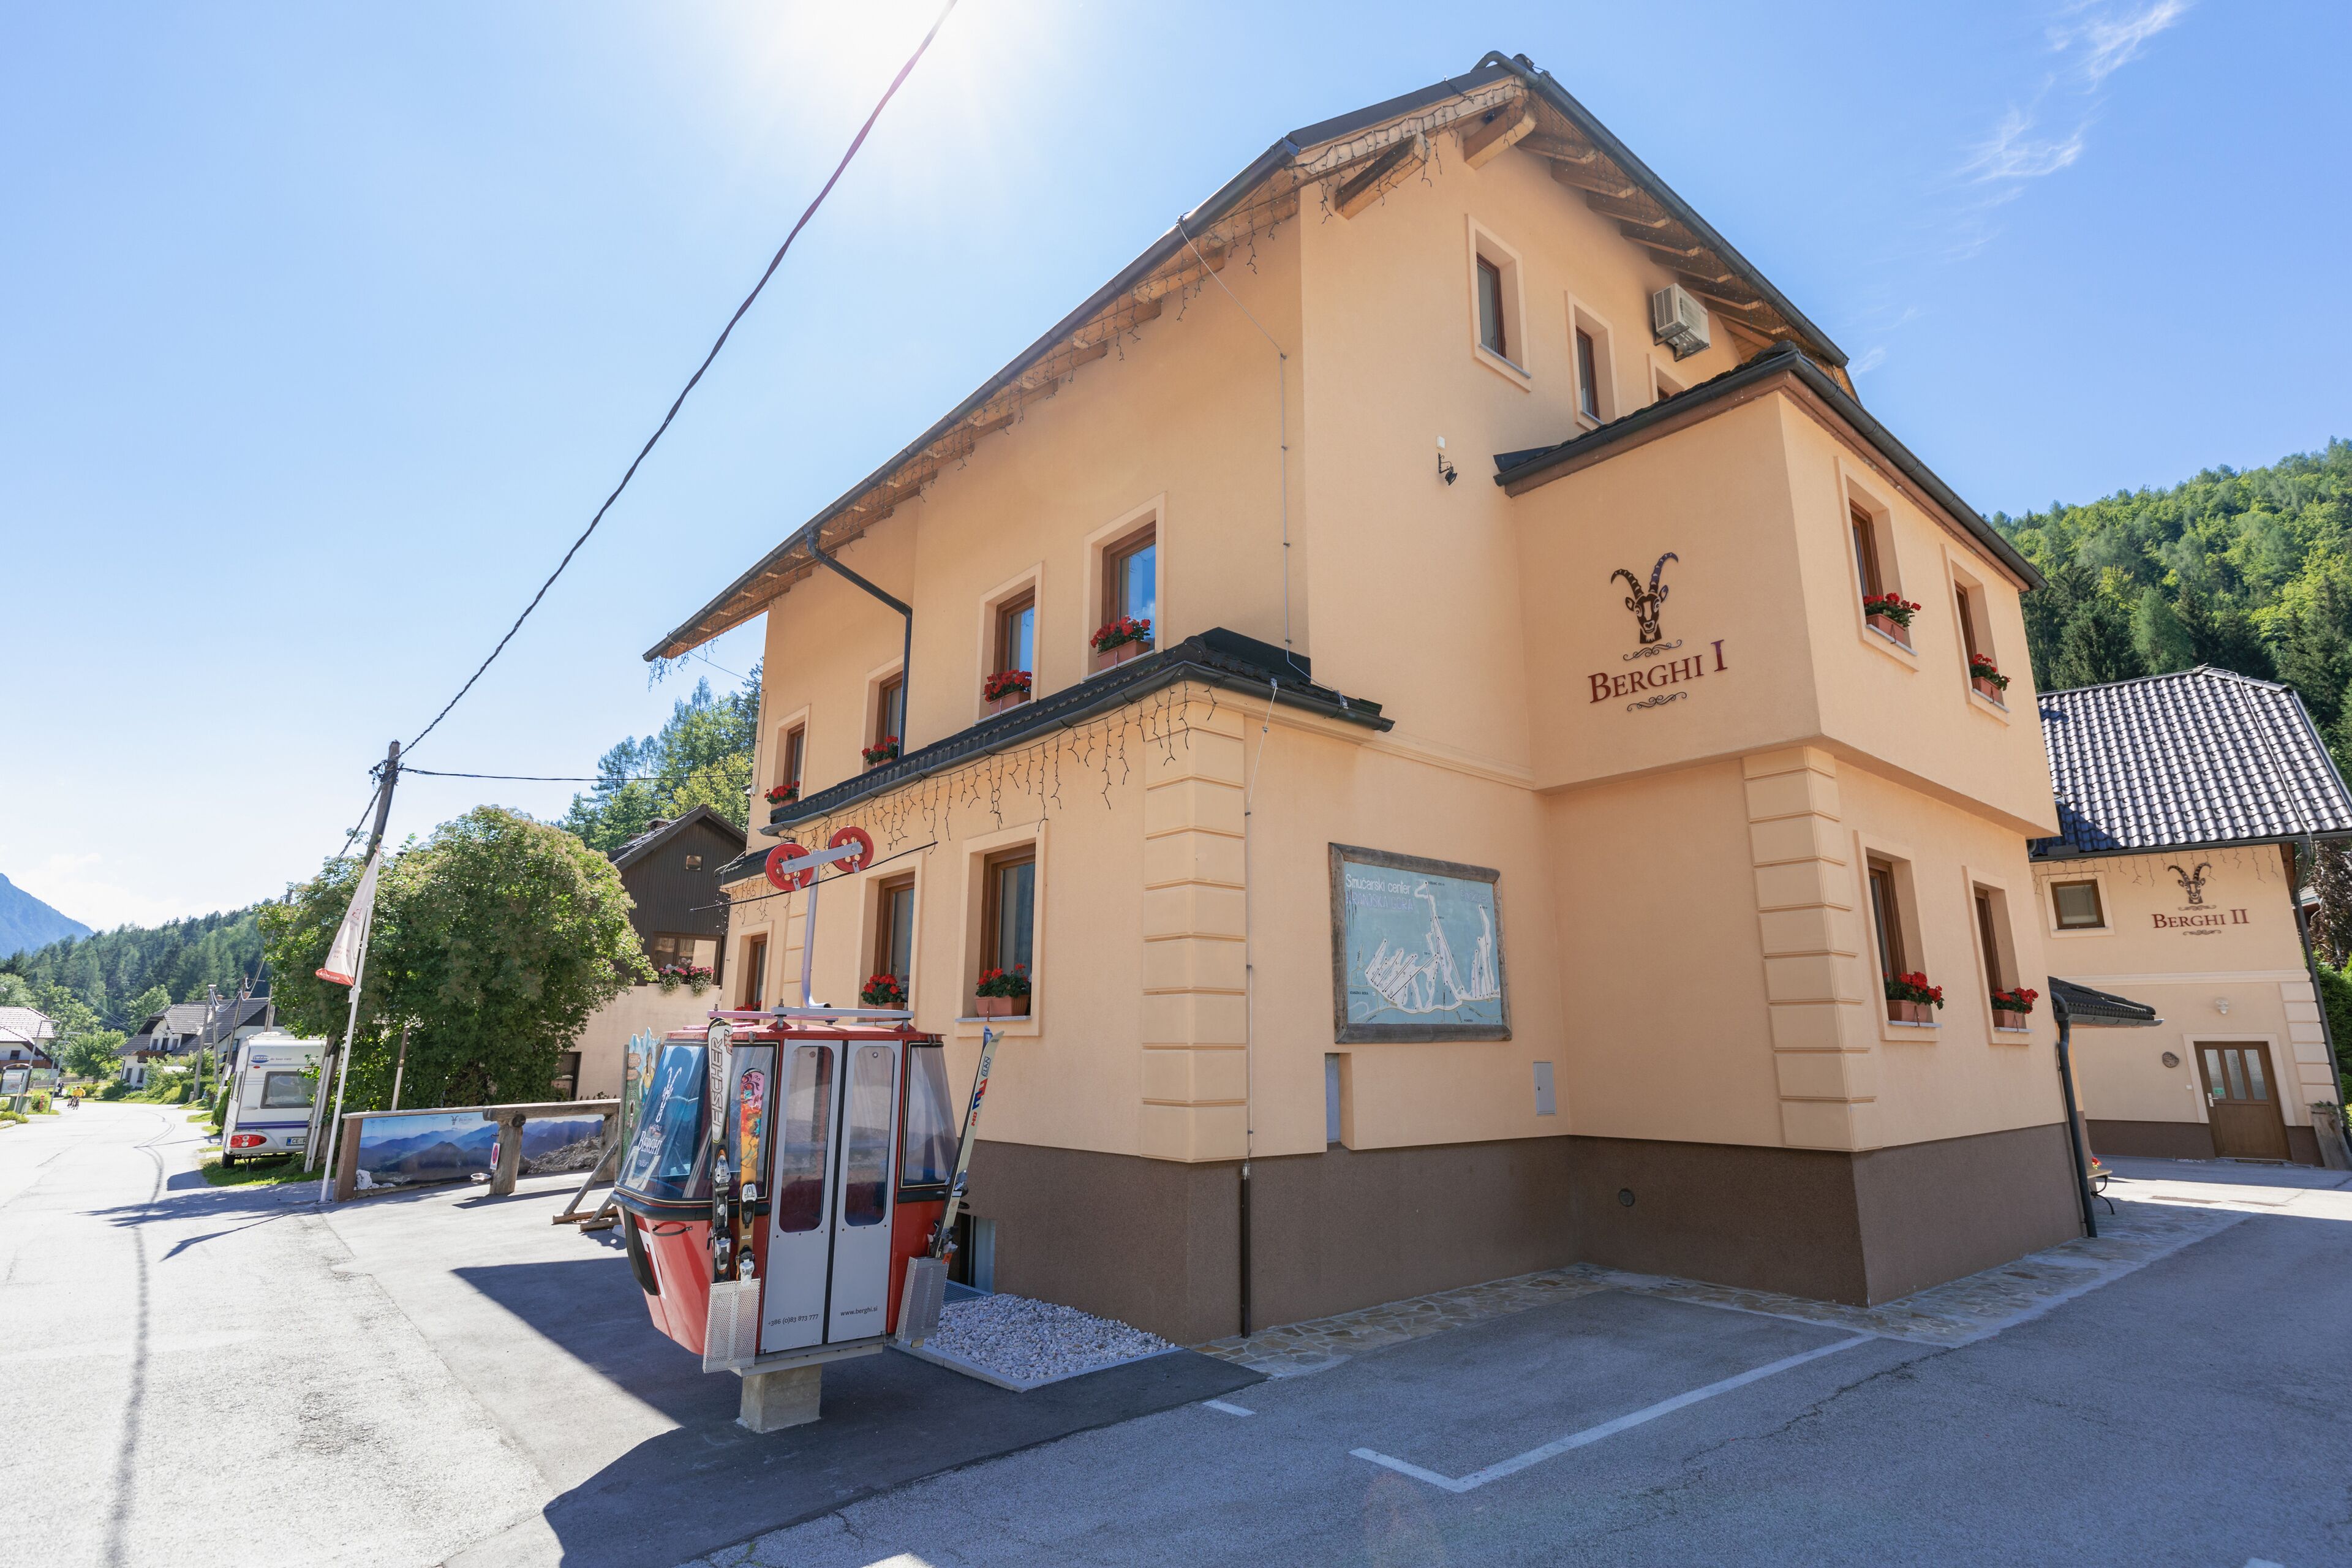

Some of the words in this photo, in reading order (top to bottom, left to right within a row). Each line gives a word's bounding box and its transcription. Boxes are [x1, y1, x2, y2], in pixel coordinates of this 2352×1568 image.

[1587, 655, 1705, 704] BERGHI
[1711, 639, 1728, 673] I
[1387, 881, 1411, 895] center
[1391, 896, 1414, 911] GORA
[2151, 913, 2227, 929] BERGHI
[2230, 908, 2250, 925] II
[982, 1057, 990, 1077] ELAN
[710, 1037, 723, 1127] FISCHER
[782, 1314, 797, 1325] (0)83
[840, 1305, 878, 1317] www.berghi.si
